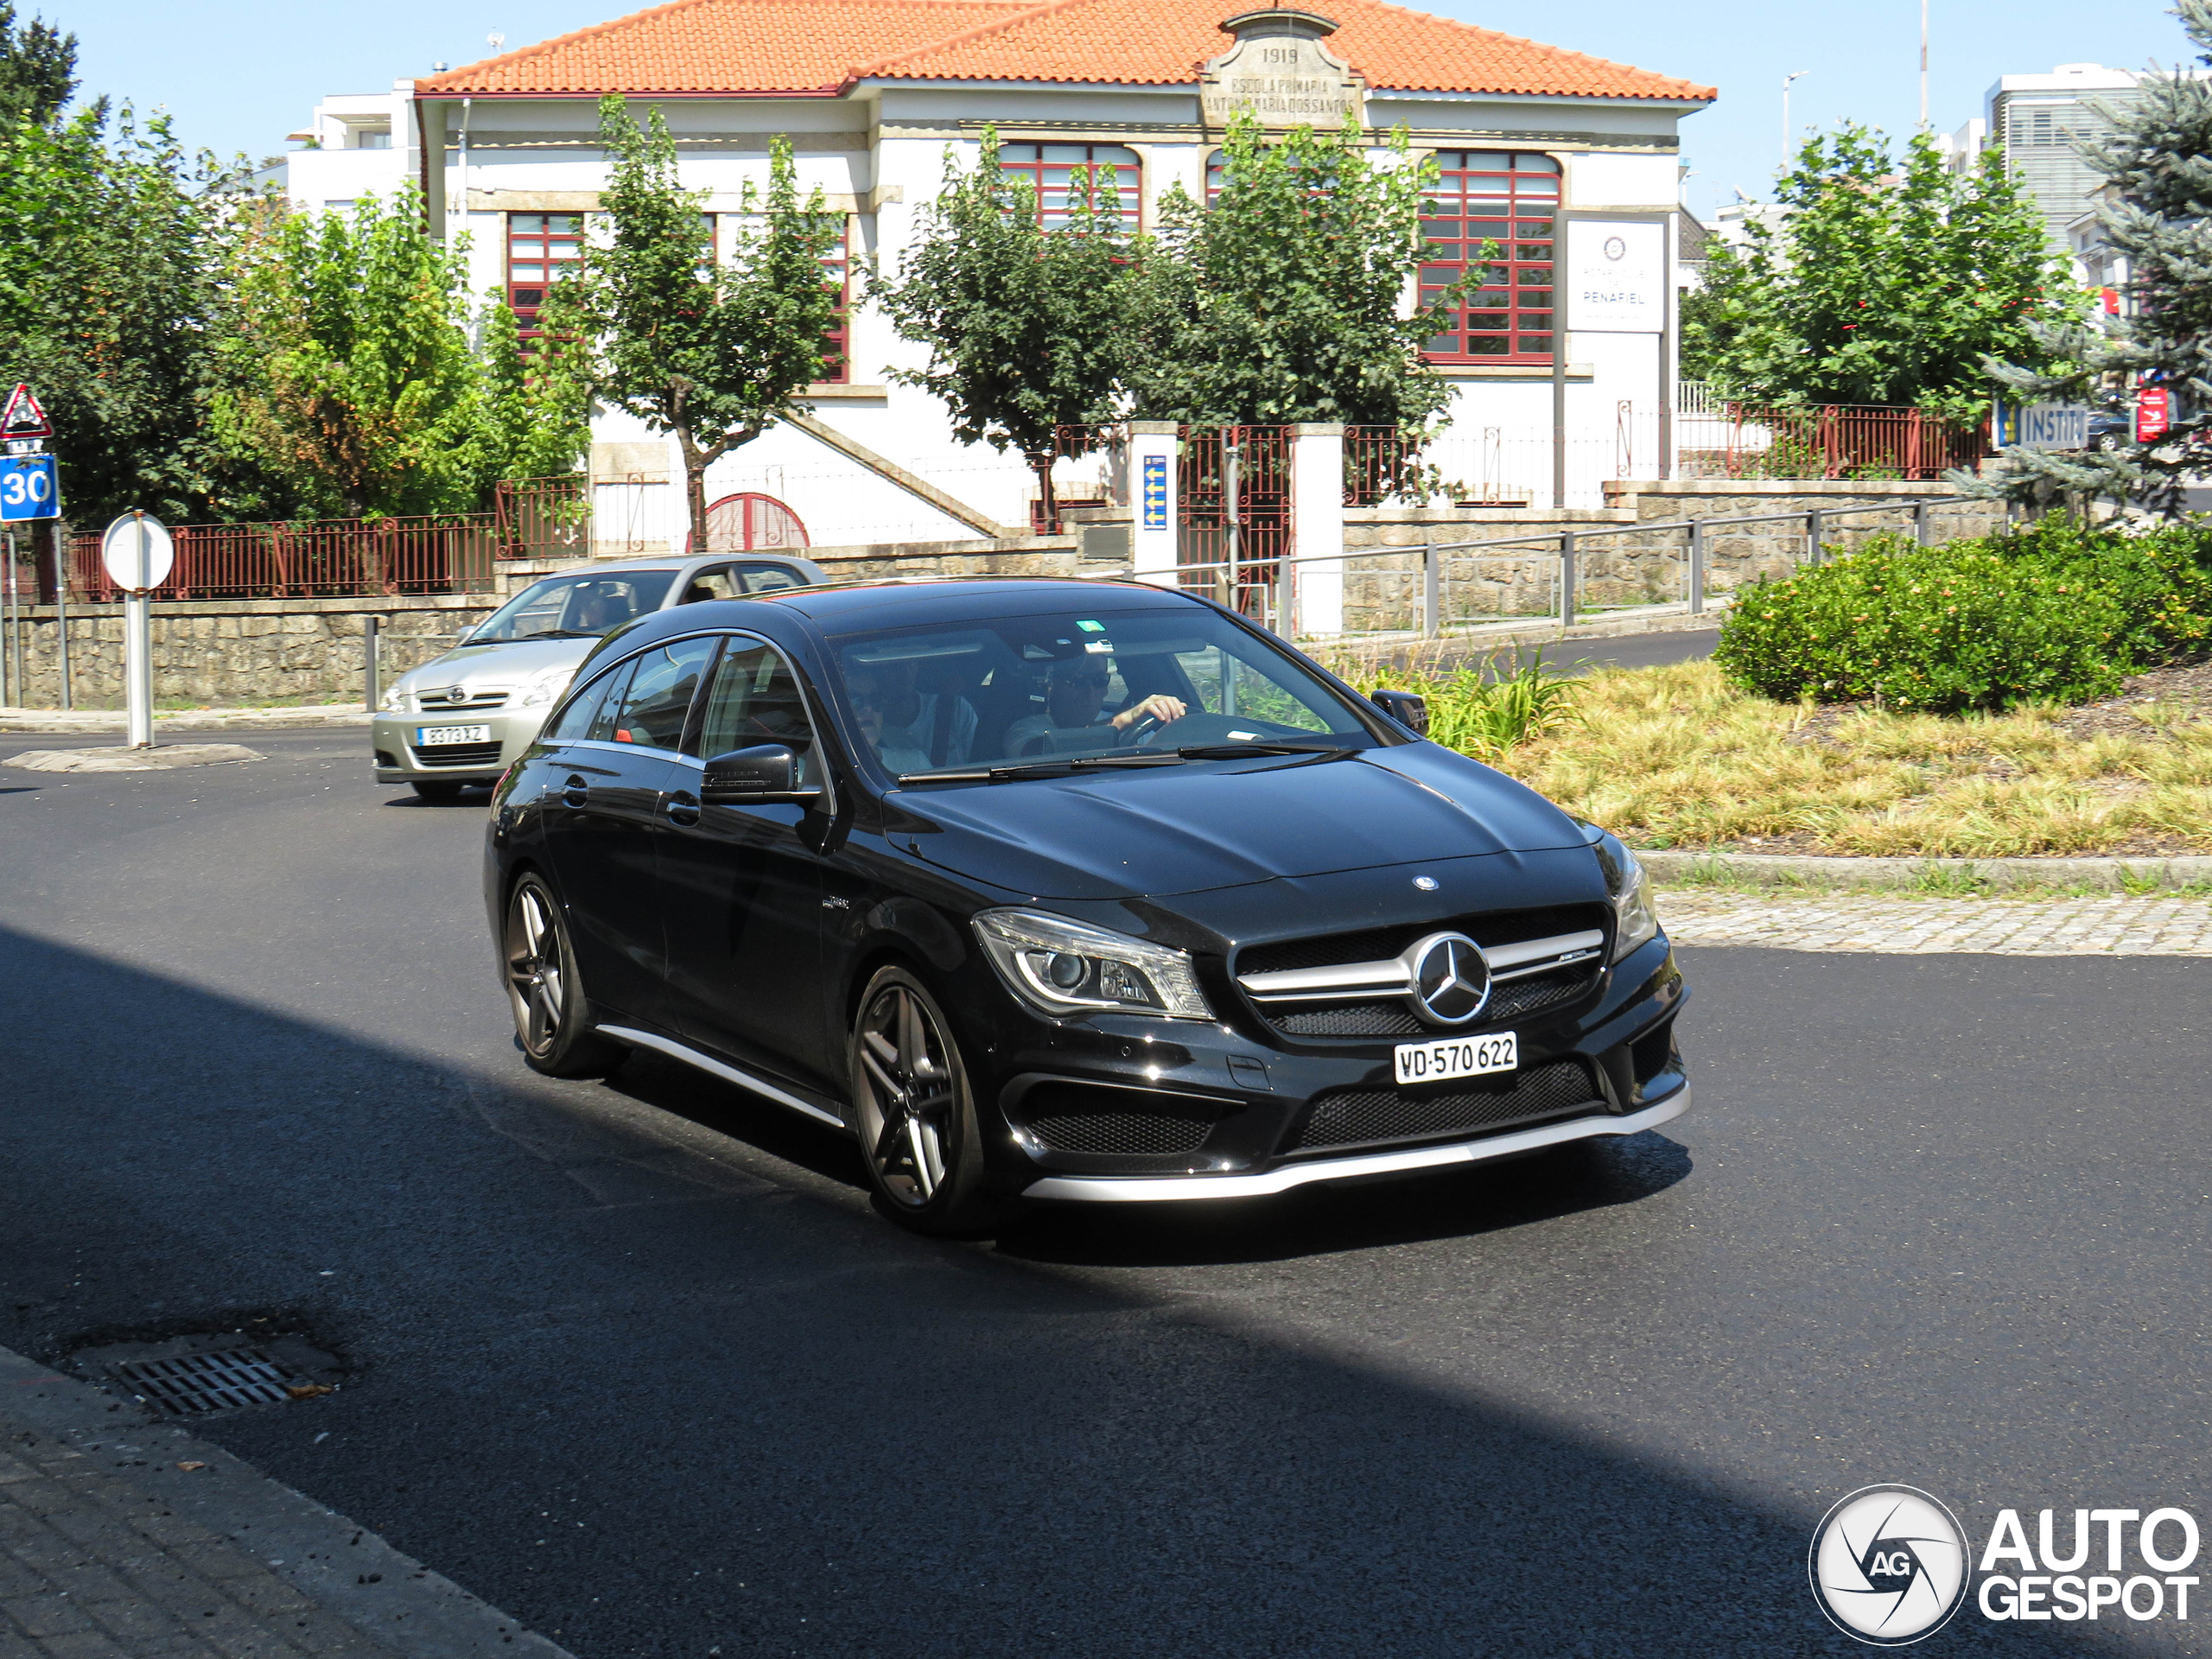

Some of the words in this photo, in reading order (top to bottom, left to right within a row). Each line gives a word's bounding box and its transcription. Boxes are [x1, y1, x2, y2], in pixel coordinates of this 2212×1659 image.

[1262, 48, 1299, 64] 1919
[1231, 78, 1275, 93] ESCOLA
[1583, 291, 1645, 305] PENAFIEL
[3, 470, 52, 505] 30
